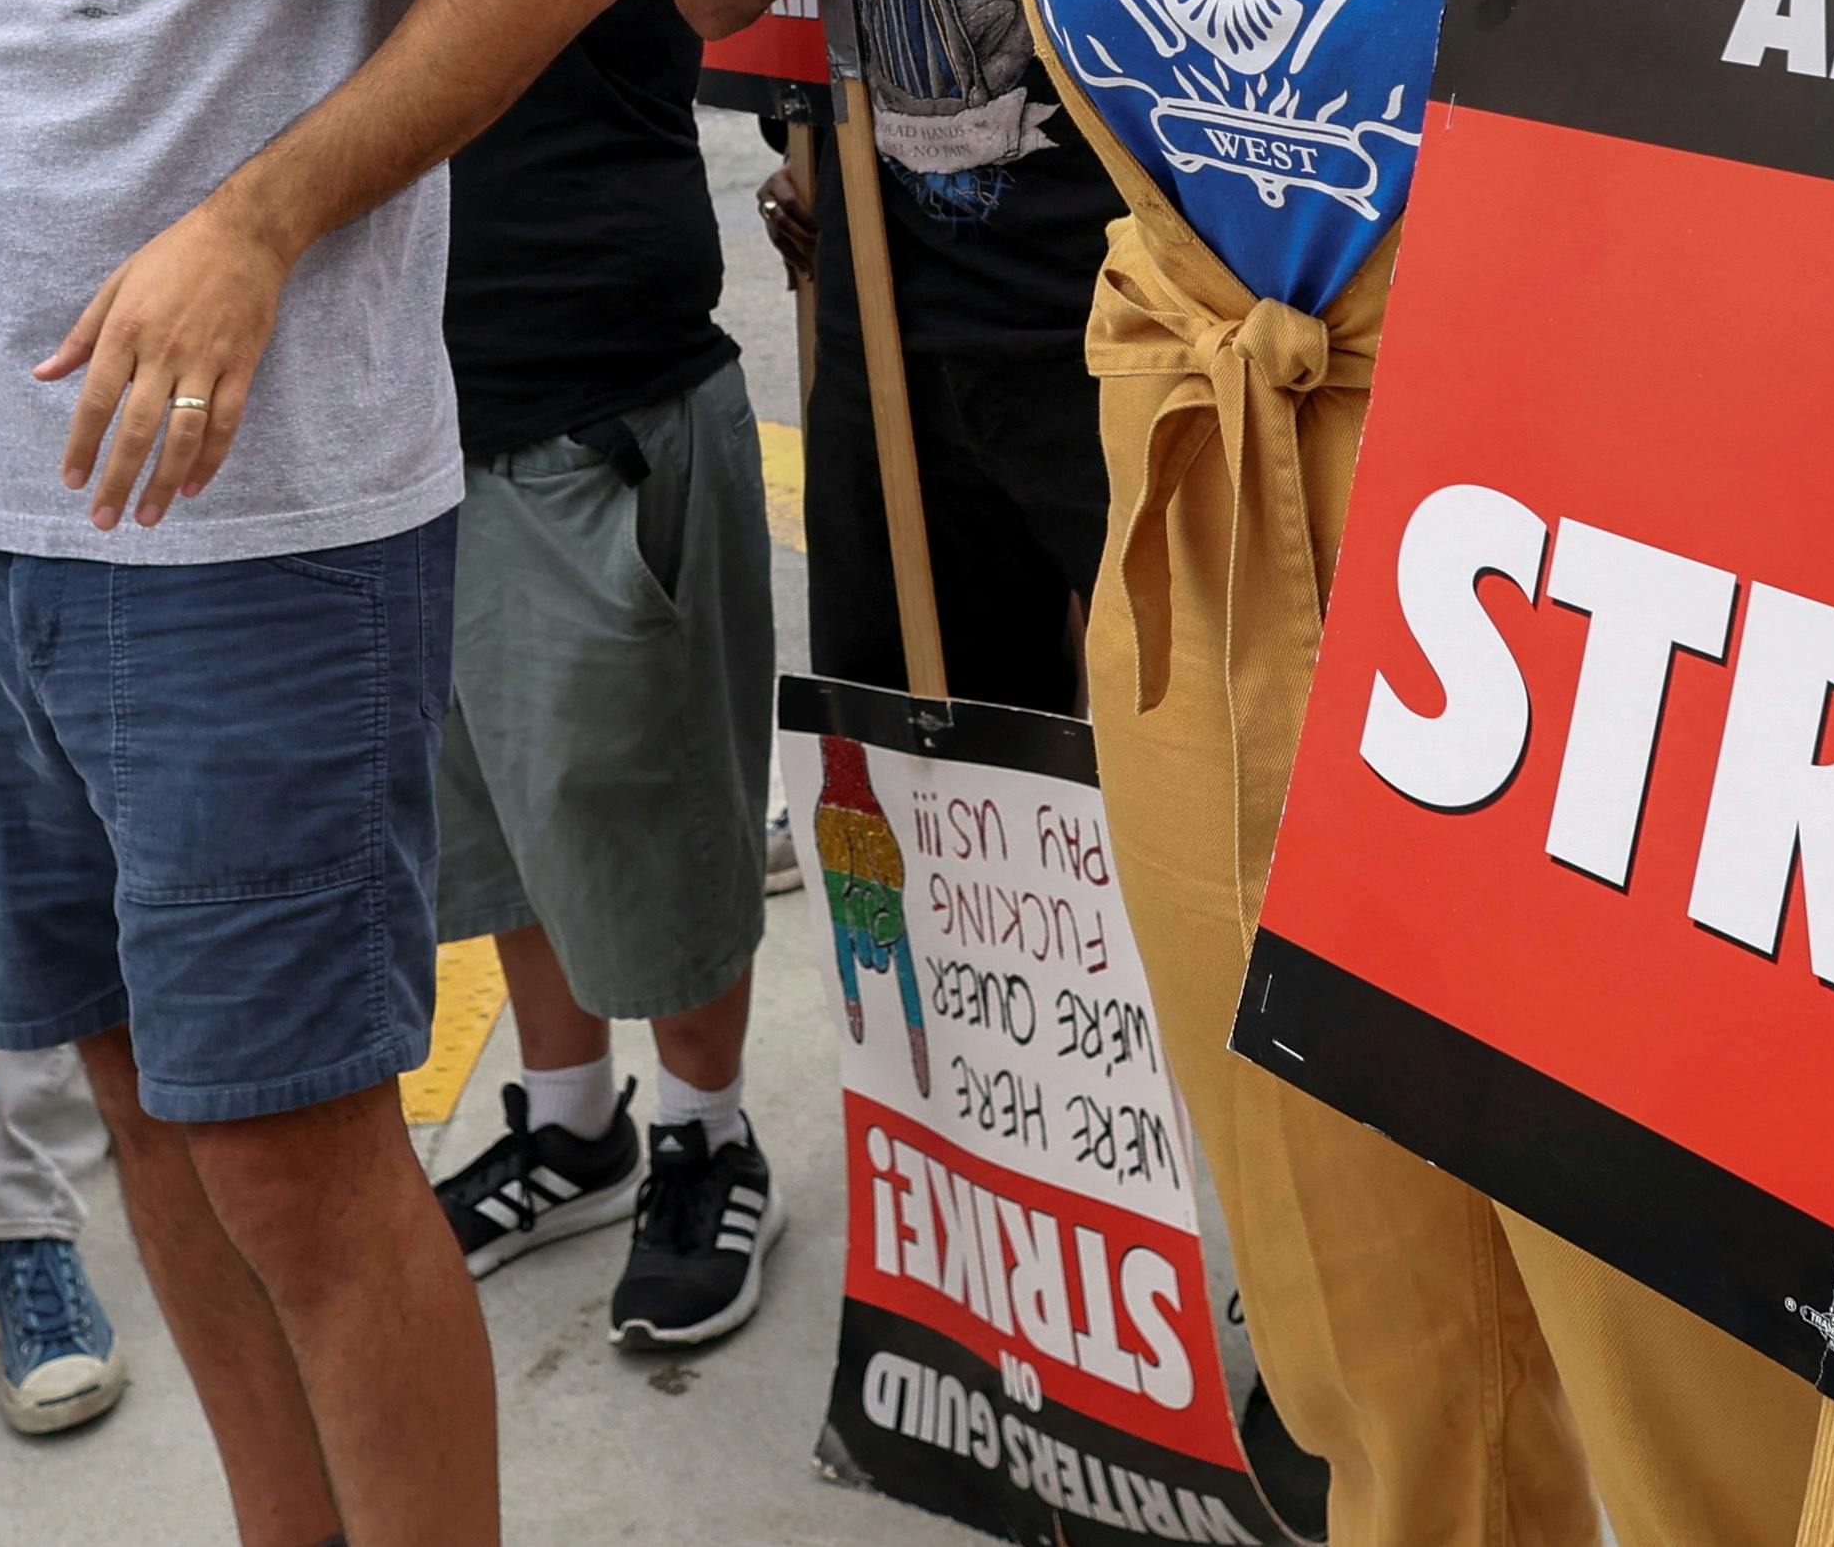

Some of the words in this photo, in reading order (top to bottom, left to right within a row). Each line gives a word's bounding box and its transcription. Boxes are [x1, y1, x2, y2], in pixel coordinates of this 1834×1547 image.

[1202, 128, 1318, 174] WEST
[1037, 805, 1110, 887] PAY
[929, 873, 1107, 974] FUCKING
[926, 957, 1036, 1046] QUEER
[949, 1057, 1047, 1151] HERE
[864, 1124, 1194, 1411] STRIKE!
[863, 1351, 999, 1456] GUILD
[999, 1349, 1043, 1414] ON
[1001, 1413, 1261, 1547] WRITERS
